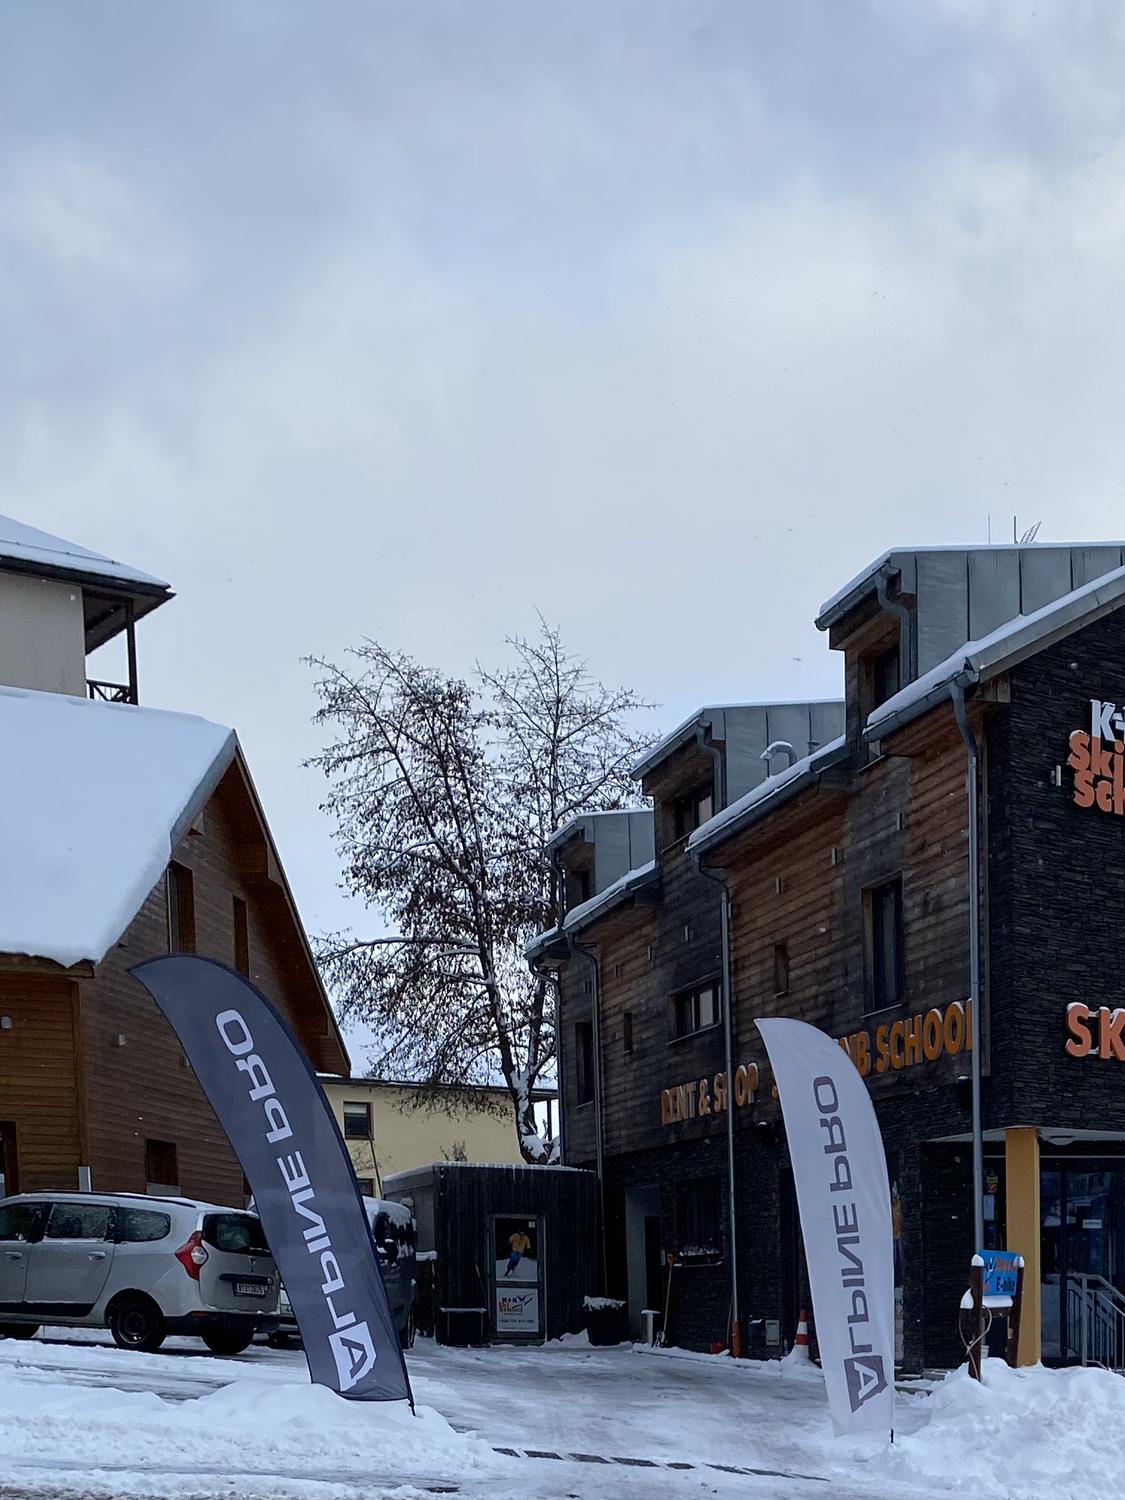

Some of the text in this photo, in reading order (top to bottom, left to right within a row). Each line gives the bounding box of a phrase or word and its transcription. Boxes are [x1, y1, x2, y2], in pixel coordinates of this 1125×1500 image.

[1067, 729, 1125, 778] Ski
[661, 1081, 697, 1125] RENT
[698, 1078, 711, 1116] &
